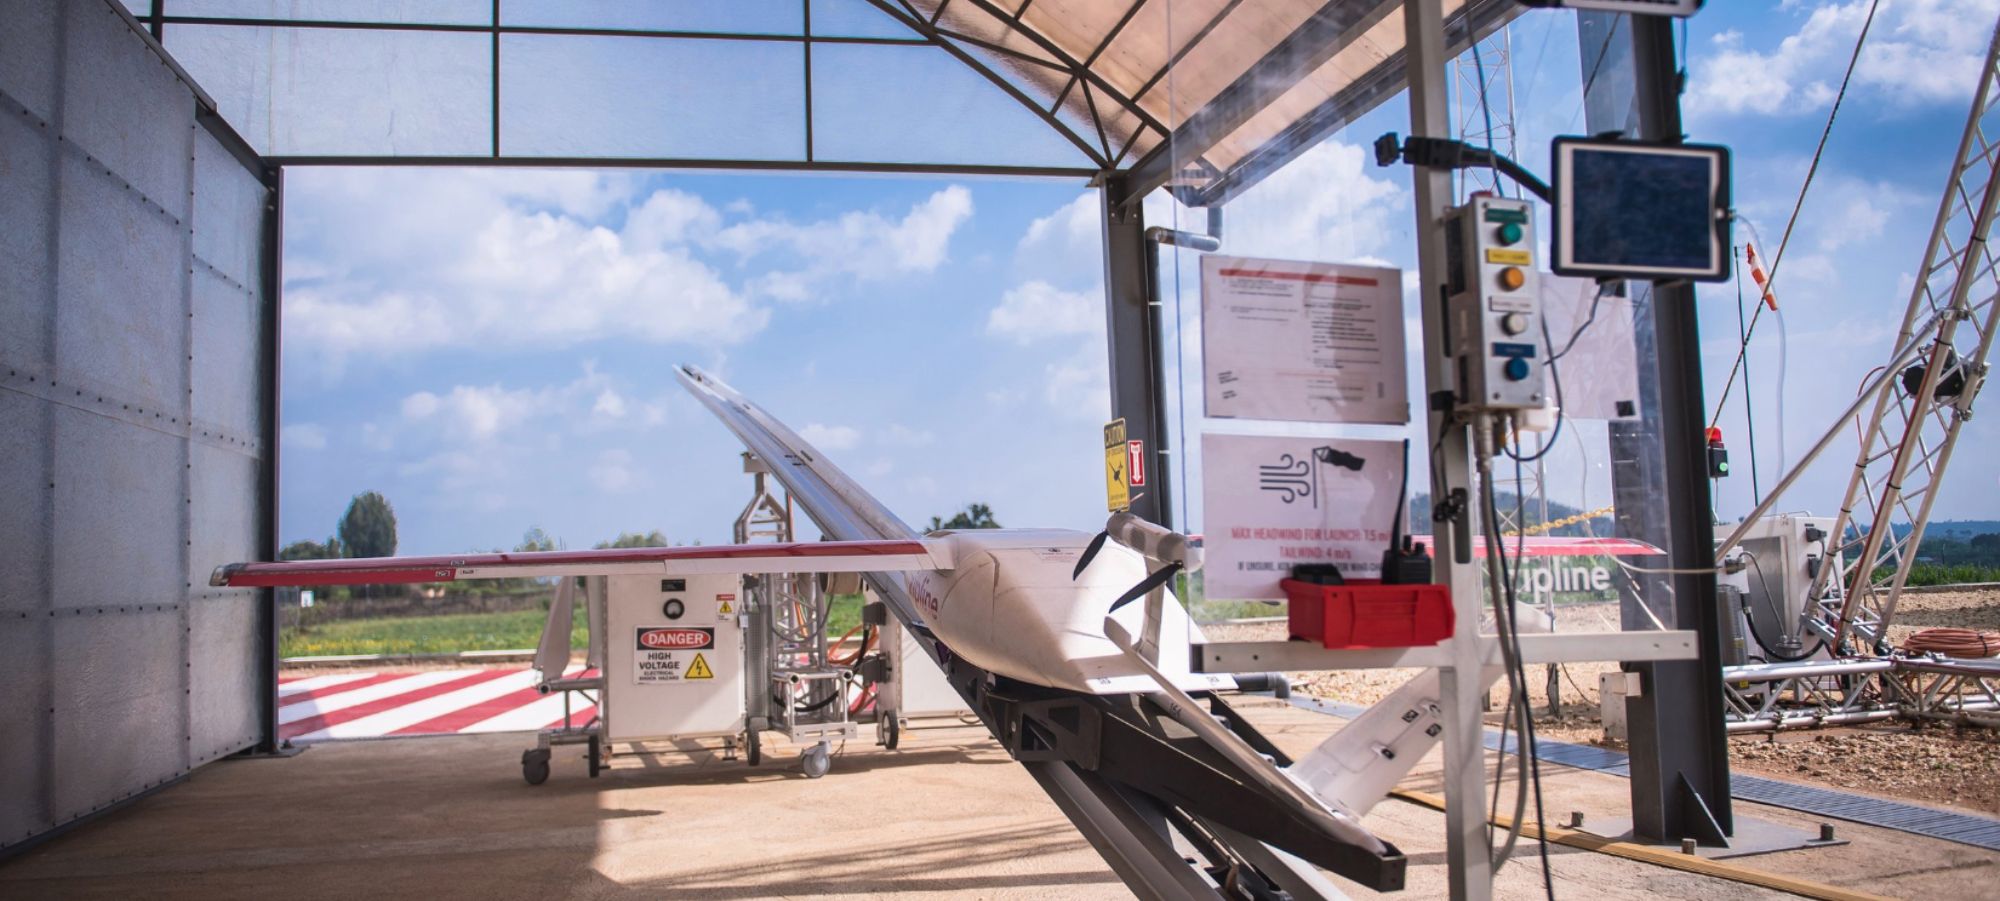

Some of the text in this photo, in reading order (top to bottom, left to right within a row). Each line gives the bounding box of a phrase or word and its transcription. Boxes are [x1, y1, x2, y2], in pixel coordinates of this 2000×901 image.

[1231, 528, 1251, 539] MAX
[1254, 528, 1303, 540] HEADWIND
[1304, 528, 1321, 540] FOR
[648, 633, 704, 645] DANGER
[648, 652, 671, 660] HIGH
[639, 661, 680, 670] VOLTAGE
